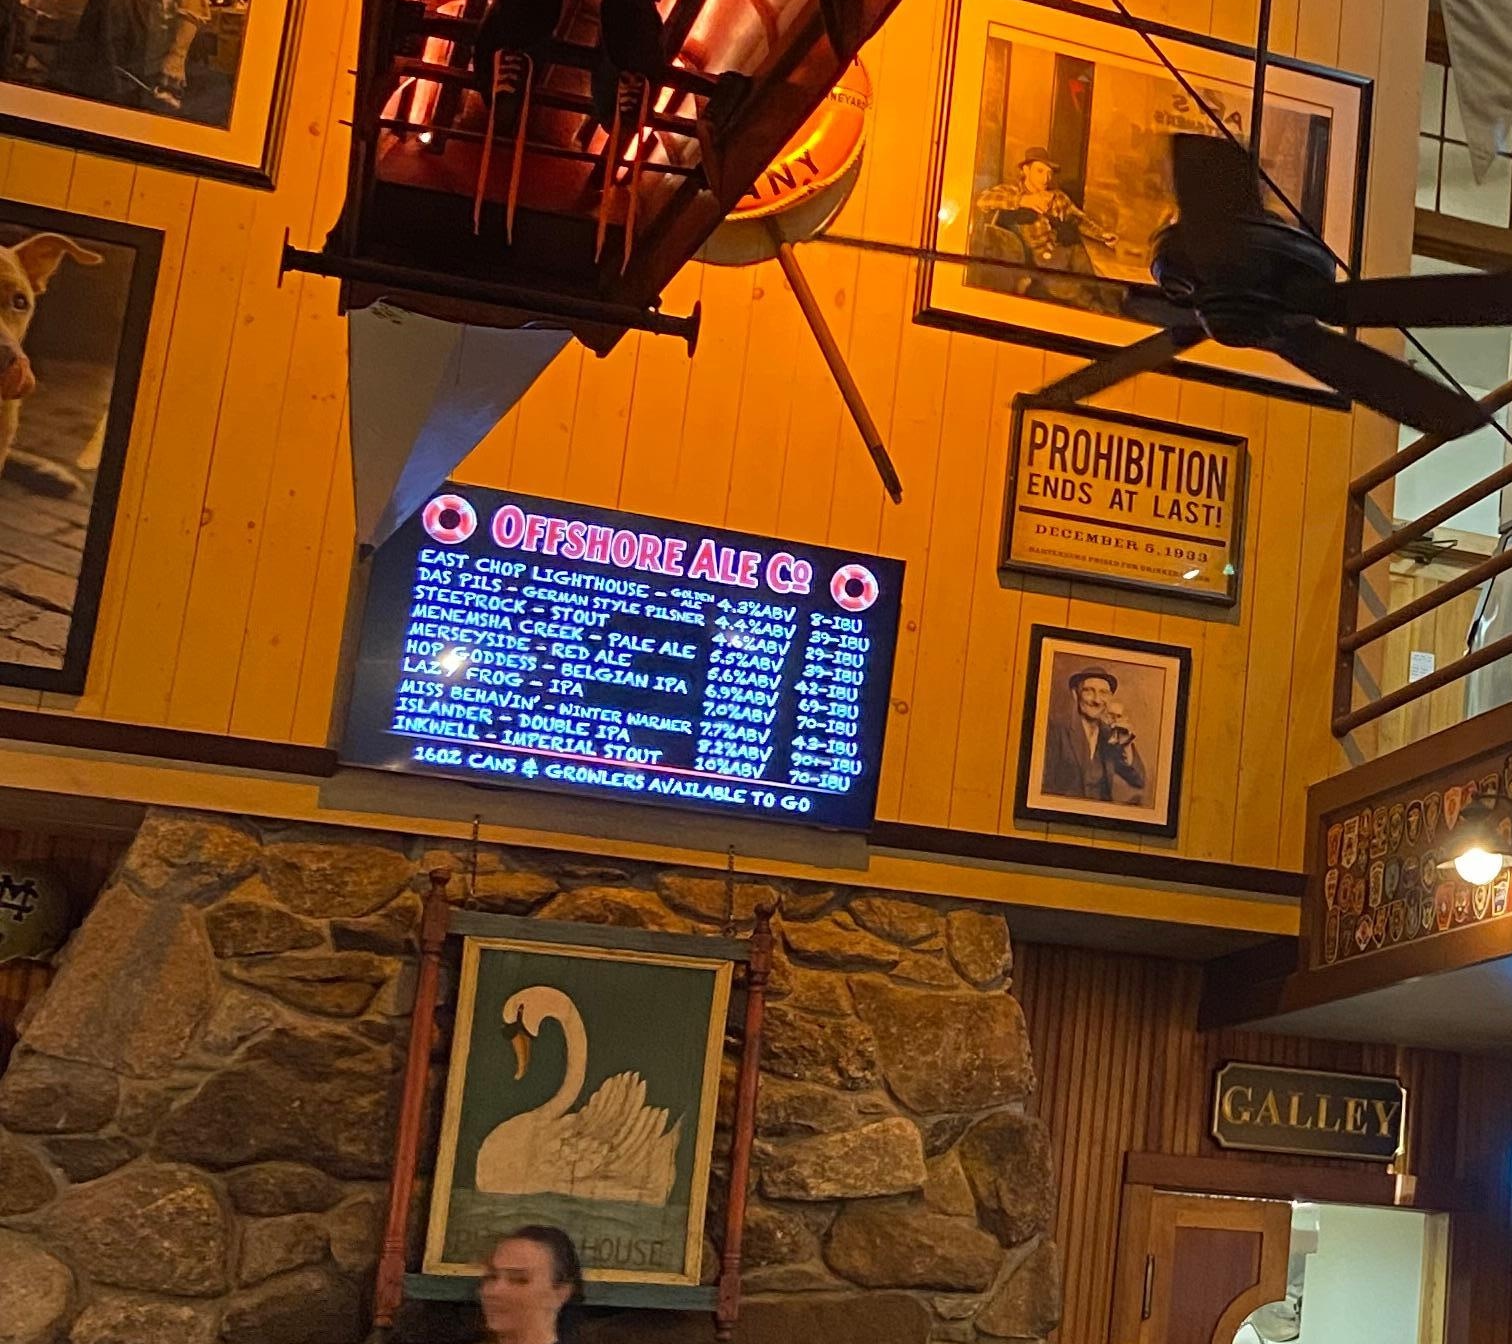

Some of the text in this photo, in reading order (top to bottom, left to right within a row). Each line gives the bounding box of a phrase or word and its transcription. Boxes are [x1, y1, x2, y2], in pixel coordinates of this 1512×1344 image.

[1027, 419, 1229, 502] PROHIBITION
[1026, 472, 1224, 529] ENDS AT LAST!
[420, 548, 469, 569] EAST
[491, 504, 687, 577] OFFSHORE
[687, 538, 762, 589] ALE
[1034, 524, 1139, 551] DECEMBER
[475, 557, 527, 579] CHOP
[531, 565, 650, 598] LIGHTHOUSE
[414, 584, 528, 614] STEEPROCK
[550, 606, 611, 628] STOUT
[418, 567, 452, 585] DAS
[457, 573, 502, 593] PILS
[522, 585, 589, 606] GERMAN
[592, 596, 641, 615] STYLE
[643, 605, 706, 627] PILSNER
[714, 616, 798, 640] 4.4%ABV
[670, 588, 715, 603] GOLDEN
[680, 599, 702, 610] ALE
[716, 598, 797, 623] 4.3%ABV
[408, 621, 532, 652] MERSEYSIDE
[550, 643, 591, 661] RED
[594, 649, 633, 667] ALE
[410, 603, 513, 632] MENEMSHA
[518, 619, 585, 641] CREEK
[607, 632, 657, 653] PALE
[658, 641, 698, 661] ALE
[403, 656, 460, 677] LAZY
[465, 666, 524, 687] FROG
[548, 678, 585, 697] IPA
[405, 639, 445, 657] HOP
[450, 645, 539, 672] GODDESS
[560, 662, 650, 688] BELGIAN
[652, 675, 688, 695] IPA
[395, 696, 493, 725] ISLANDER
[517, 712, 591, 736] DOUBLE
[594, 724, 631, 743] IPA
[399, 678, 444, 698] MISS
[450, 686, 541, 711] BEHAVIN'
[559, 702, 622, 725] WINTER
[626, 712, 693, 735] WARMER
[392, 715, 480, 739] INKWELL
[500, 729, 598, 756] IMPERIAL
[602, 742, 664, 764] STOUT
[692, 757, 767, 780] 10%ABV
[468, 753, 518, 774] CANS
[520, 758, 540, 778] &
[543, 763, 646, 790] GROWLERS
[648, 777, 748, 804] AVAILABLE
[750, 790, 776, 808] TO
[779, 795, 811, 813] GO
[1220, 1084, 1399, 1138] GALLEY
[580, 1234, 670, 1267] HOUSE
